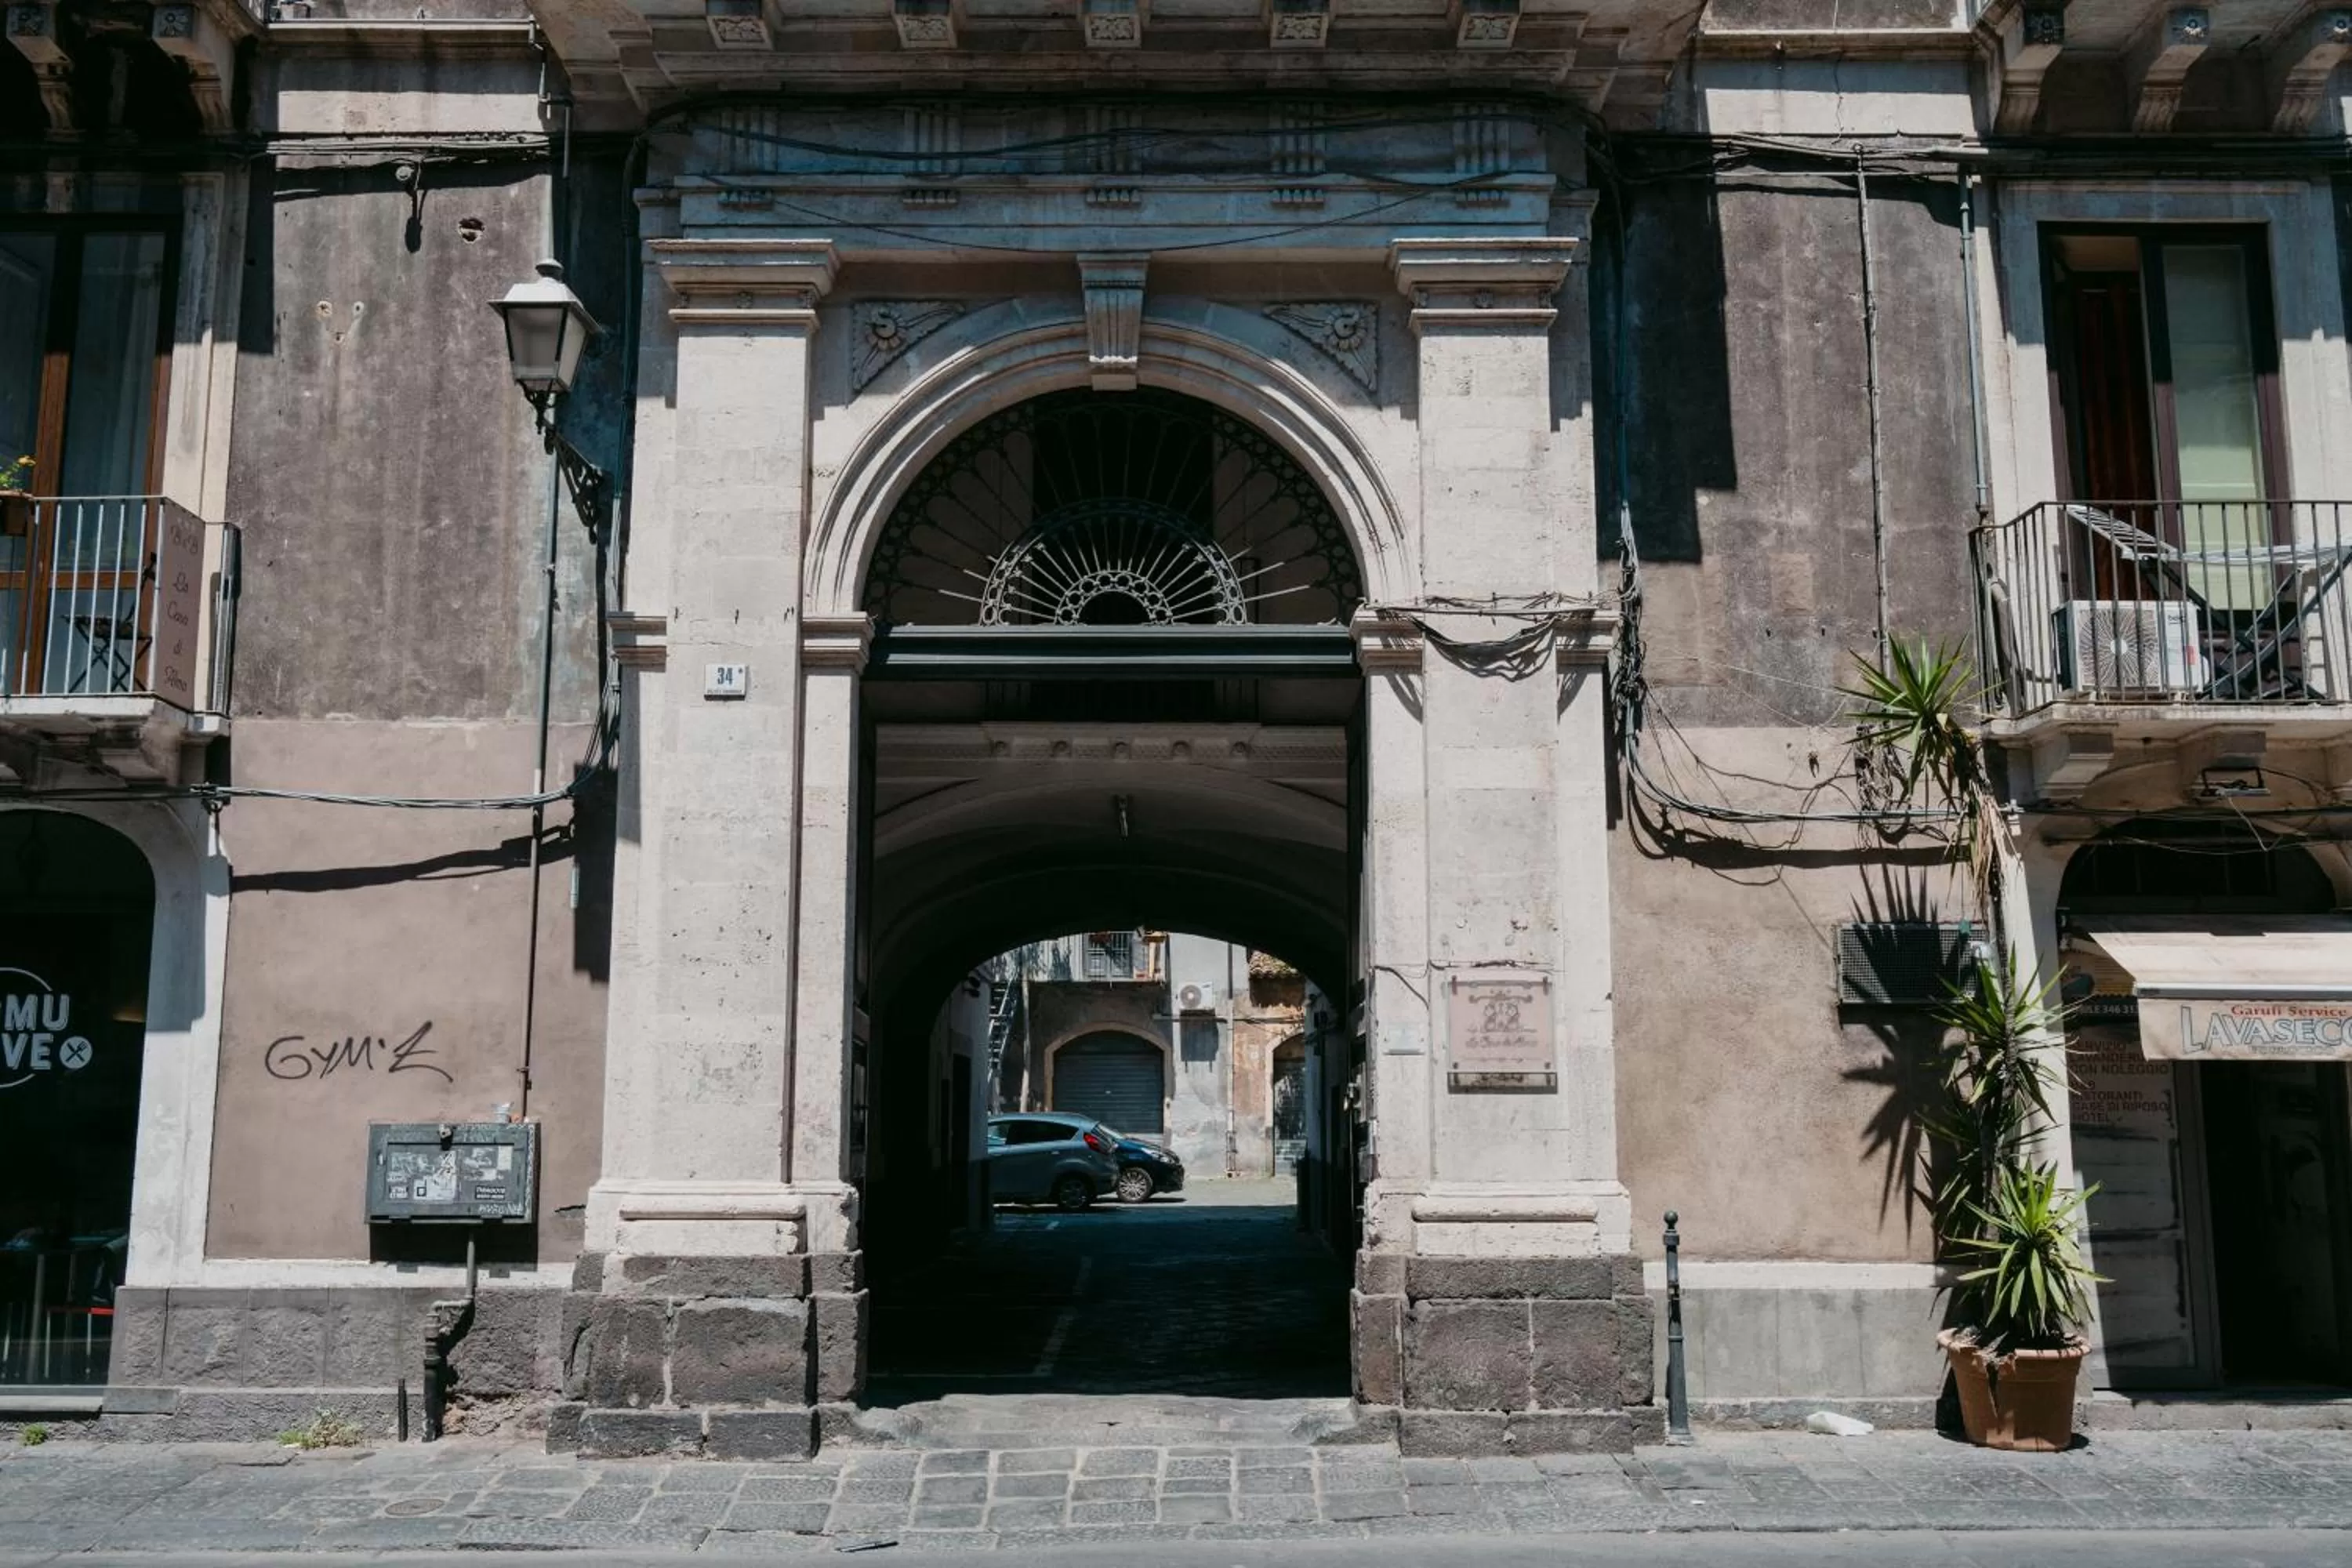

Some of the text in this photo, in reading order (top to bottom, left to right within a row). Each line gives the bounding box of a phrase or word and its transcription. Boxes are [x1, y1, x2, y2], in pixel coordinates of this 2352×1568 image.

[717, 667, 733, 684] 34
[0, 993, 71, 1031] MU
[2288, 1006, 2347, 1016] Service
